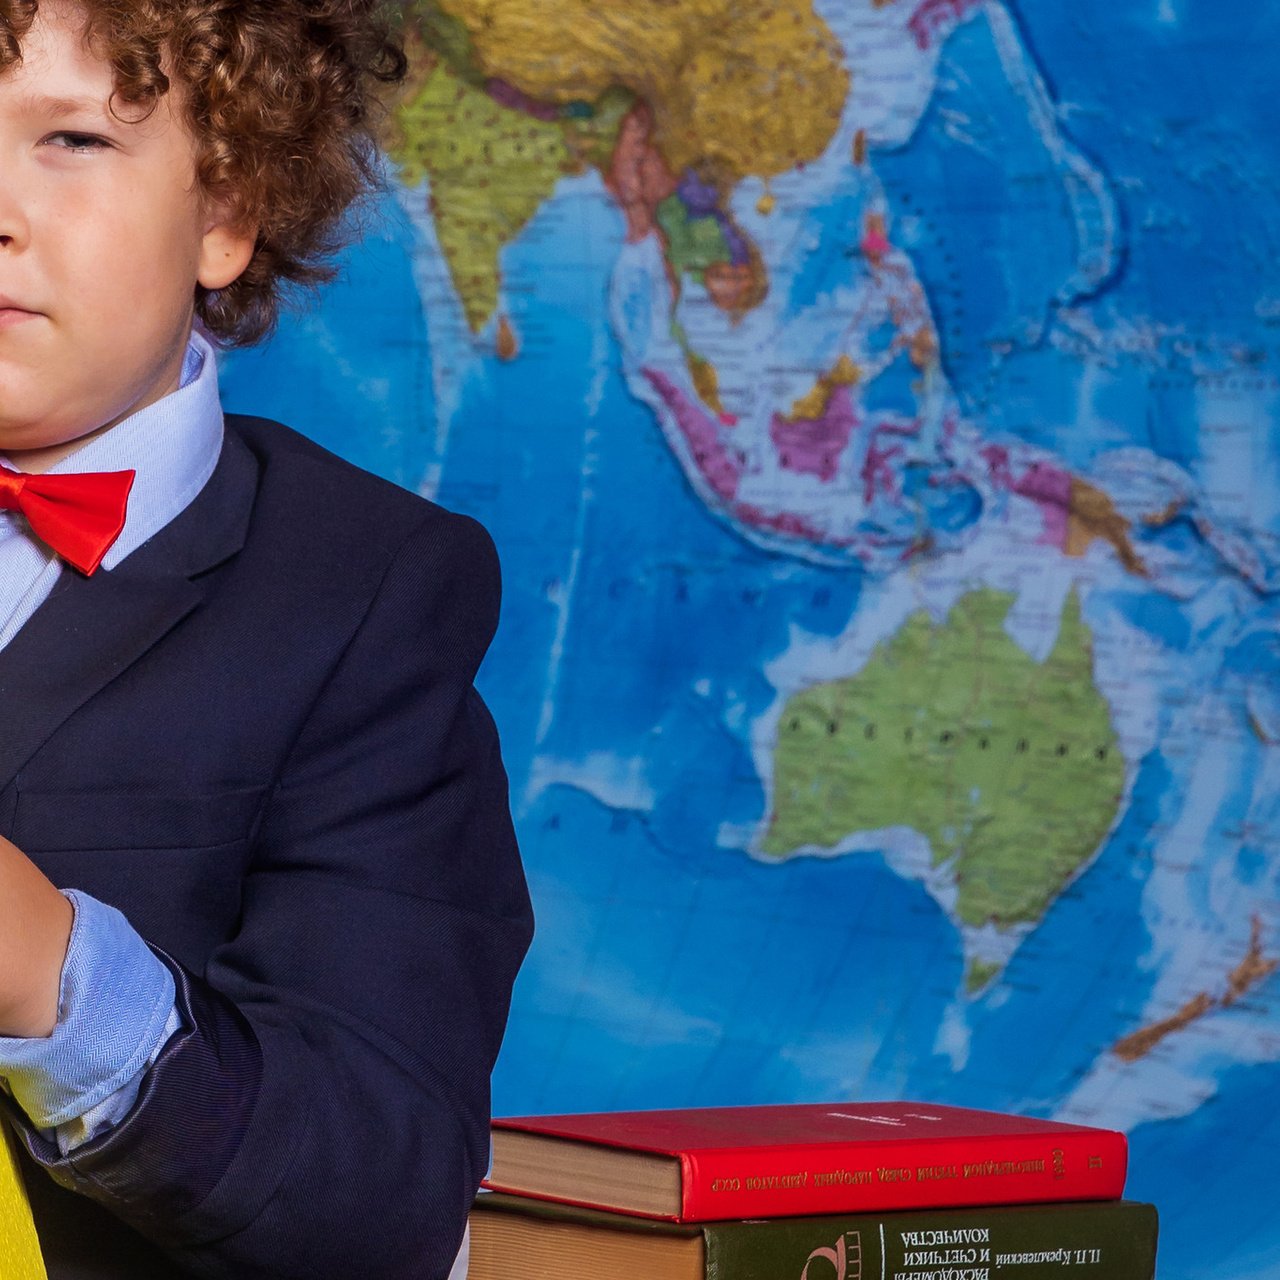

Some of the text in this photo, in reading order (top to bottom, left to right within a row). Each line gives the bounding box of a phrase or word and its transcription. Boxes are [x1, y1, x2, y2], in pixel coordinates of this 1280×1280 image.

[746, 1171, 808, 1191] ДЕПУТАТОВ
[814, 1169, 873, 1187] НАРОДНЫХ
[876, 1166, 911, 1183] СЪЕЗД
[916, 1165, 957, 1182] ТРЕТИЙ
[711, 1177, 740, 1192] СССР
[900, 1228, 990, 1249] КОЛИЧЕСТВА
[903, 1248, 991, 1267] И СЧЕТЧИКИ
[995, 1248, 1072, 1269] Кремлевский
